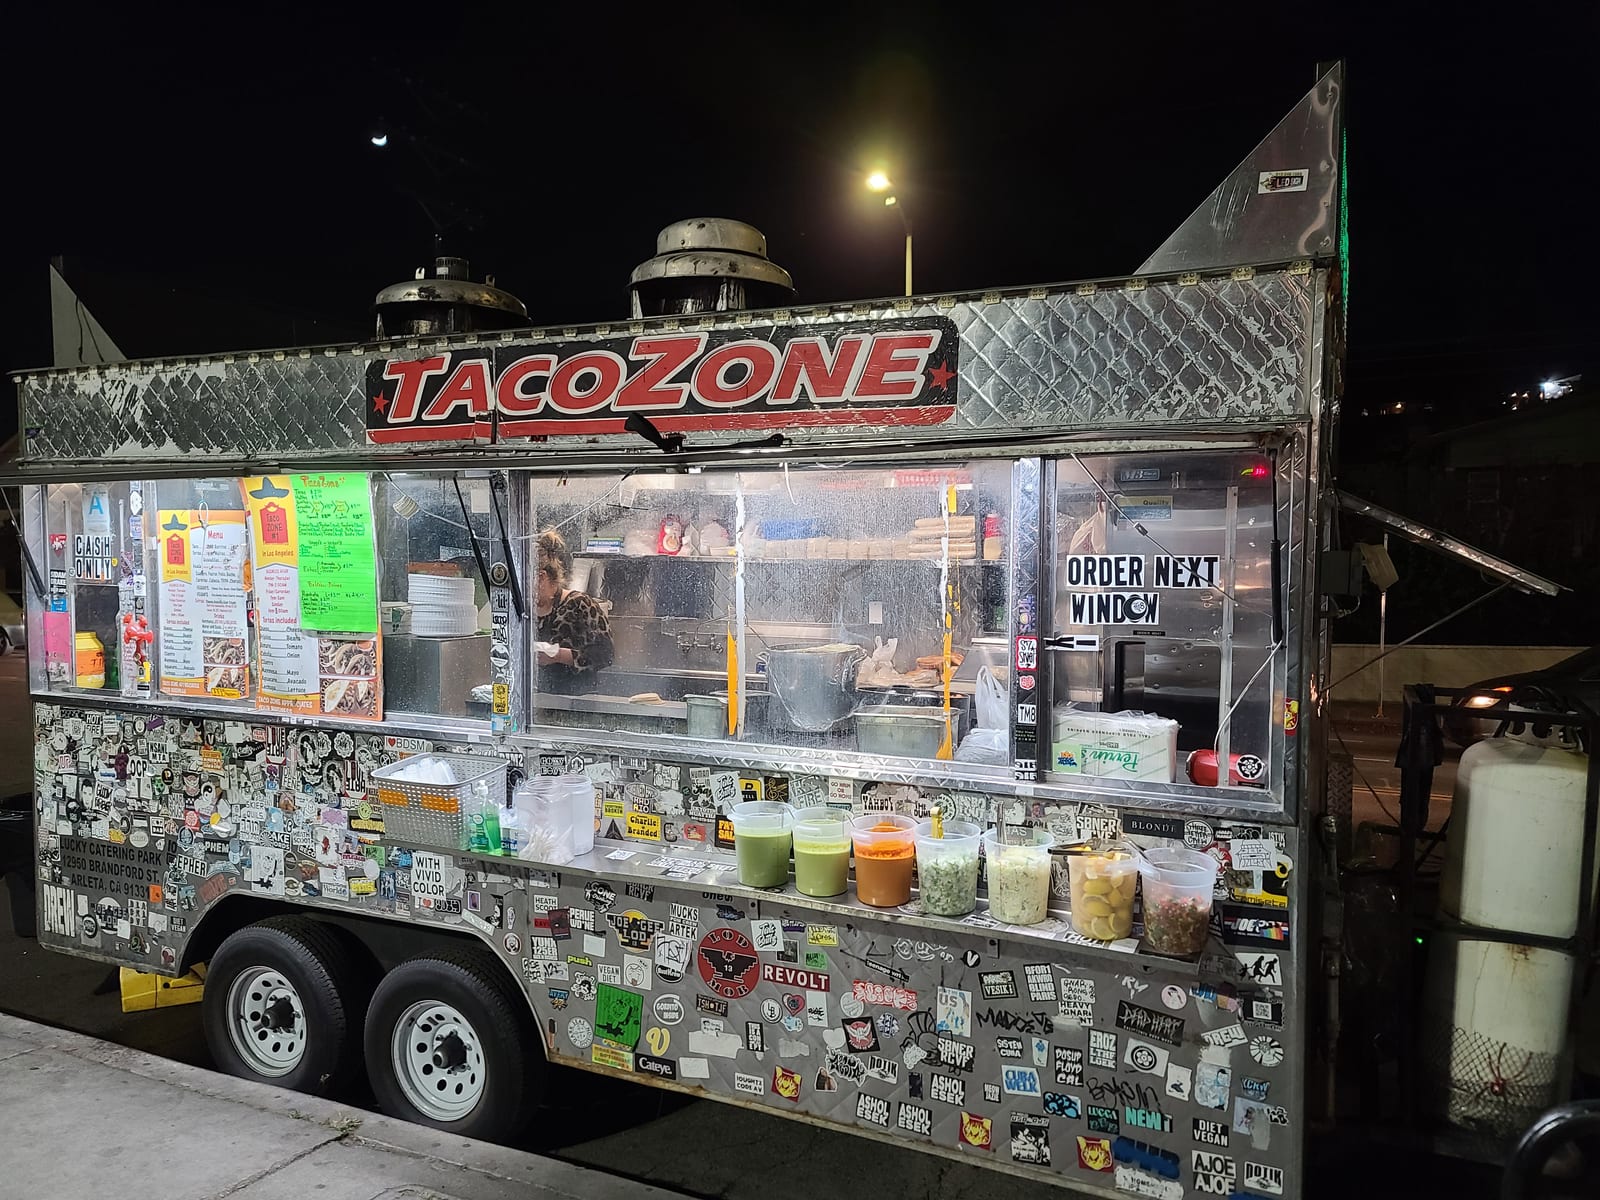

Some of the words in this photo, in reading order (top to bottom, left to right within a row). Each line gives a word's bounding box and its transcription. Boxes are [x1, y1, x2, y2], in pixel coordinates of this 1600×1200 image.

[88, 494, 104, 516] A
[76, 535, 110, 556] CASH
[274, 550, 294, 558] Angeles
[76, 558, 111, 579] ONLY
[1068, 556, 1143, 587] ORDER
[1155, 556, 1219, 588] NEXT
[1071, 594, 1158, 624] WINDW
[396, 737, 426, 751] BDSM
[60, 837, 87, 853] LUCKY
[89, 842, 135, 862] CATERING
[138, 851, 162, 867] PARK
[89, 859, 144, 881] BRANDFORD
[415, 855, 440, 870] WITH
[70, 873, 107, 893] ARLETA,
[109, 879, 122, 894] CA
[415, 869, 442, 883] VIVID
[412, 881, 445, 896] COLOR
[535, 896, 557, 905] HEATH
[611, 914, 629, 928] JOE
[670, 904, 699, 921] MUCKS
[624, 929, 647, 941] LOD
[669, 922, 697, 941] ARTEK
[567, 955, 593, 968] push
[600, 964, 620, 975] VEGAN
[602, 973, 618, 984] DIET
[764, 964, 829, 990] REVOLT
[931, 1074, 965, 1096] ASHOL
[857, 1093, 890, 1117] ASHOL
[930, 1088, 965, 1107] ESEK
[856, 1106, 890, 1127] ESEK
[899, 1102, 932, 1125] ASHOL
[897, 1117, 932, 1136] ESEK
[1199, 1119, 1223, 1134] DIET
[1193, 1129, 1228, 1147] VEGAN
[1194, 1153, 1235, 1177] AJOE
[1194, 1173, 1236, 1196] AJOE
